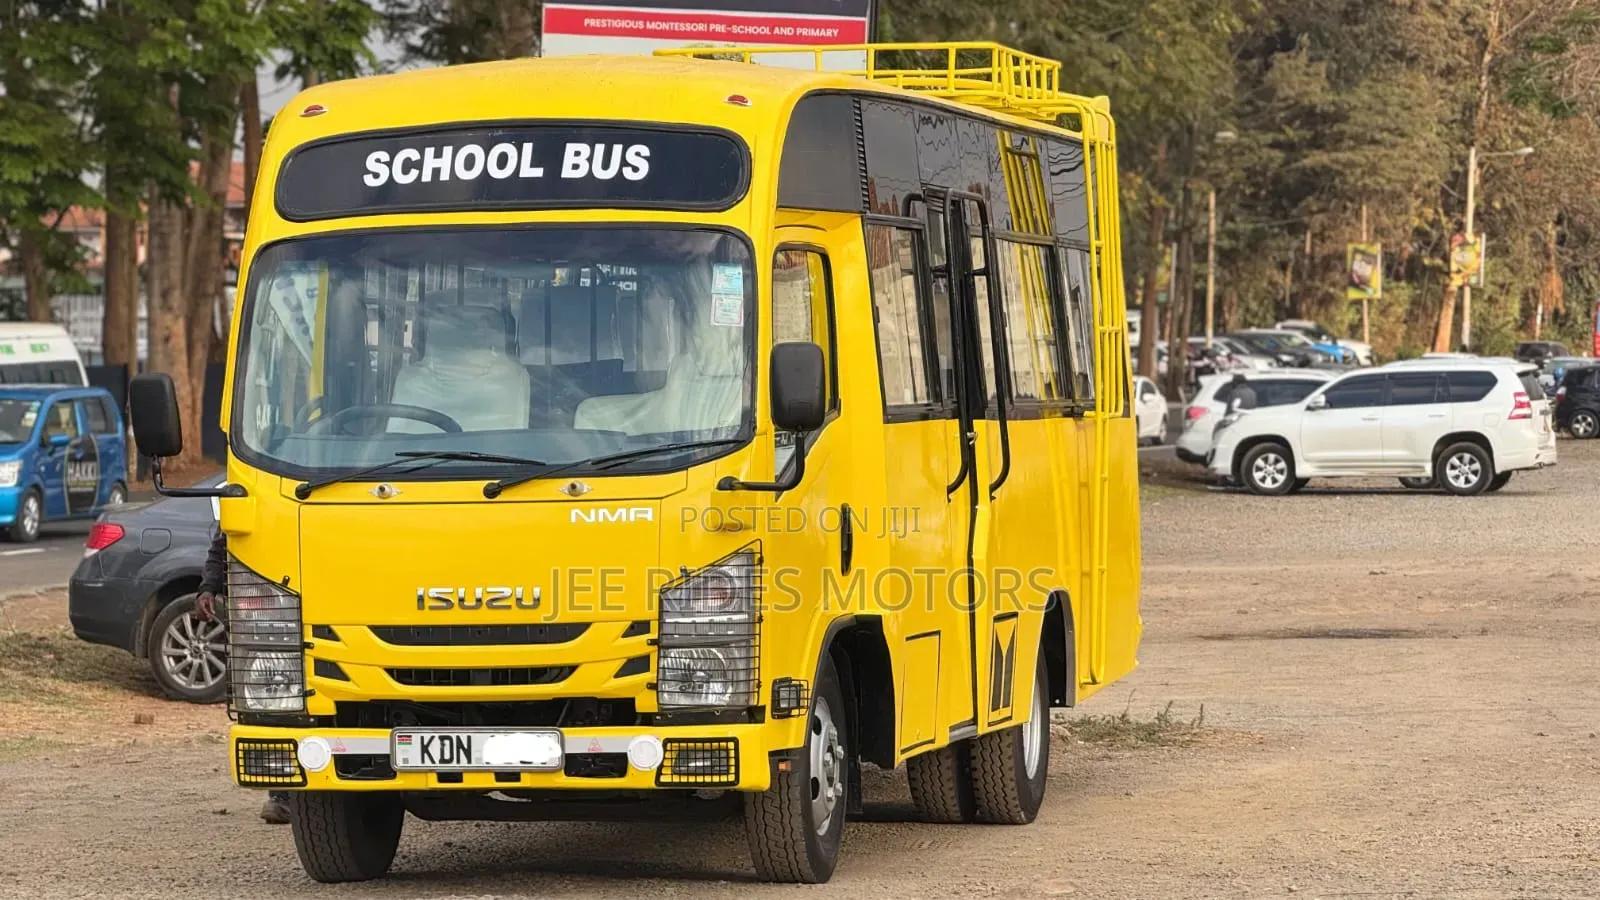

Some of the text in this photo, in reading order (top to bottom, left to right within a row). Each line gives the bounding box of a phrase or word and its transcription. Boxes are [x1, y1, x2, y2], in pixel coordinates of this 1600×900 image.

[583, 18, 839, 38] PRESTIGIOUS MONTESSORI PRE-SCHOOL AND PRIMARY
[363, 142, 650, 187] SCHOOL BUS
[416, 586, 541, 611] ISUZU
[420, 735, 472, 765] KDN
